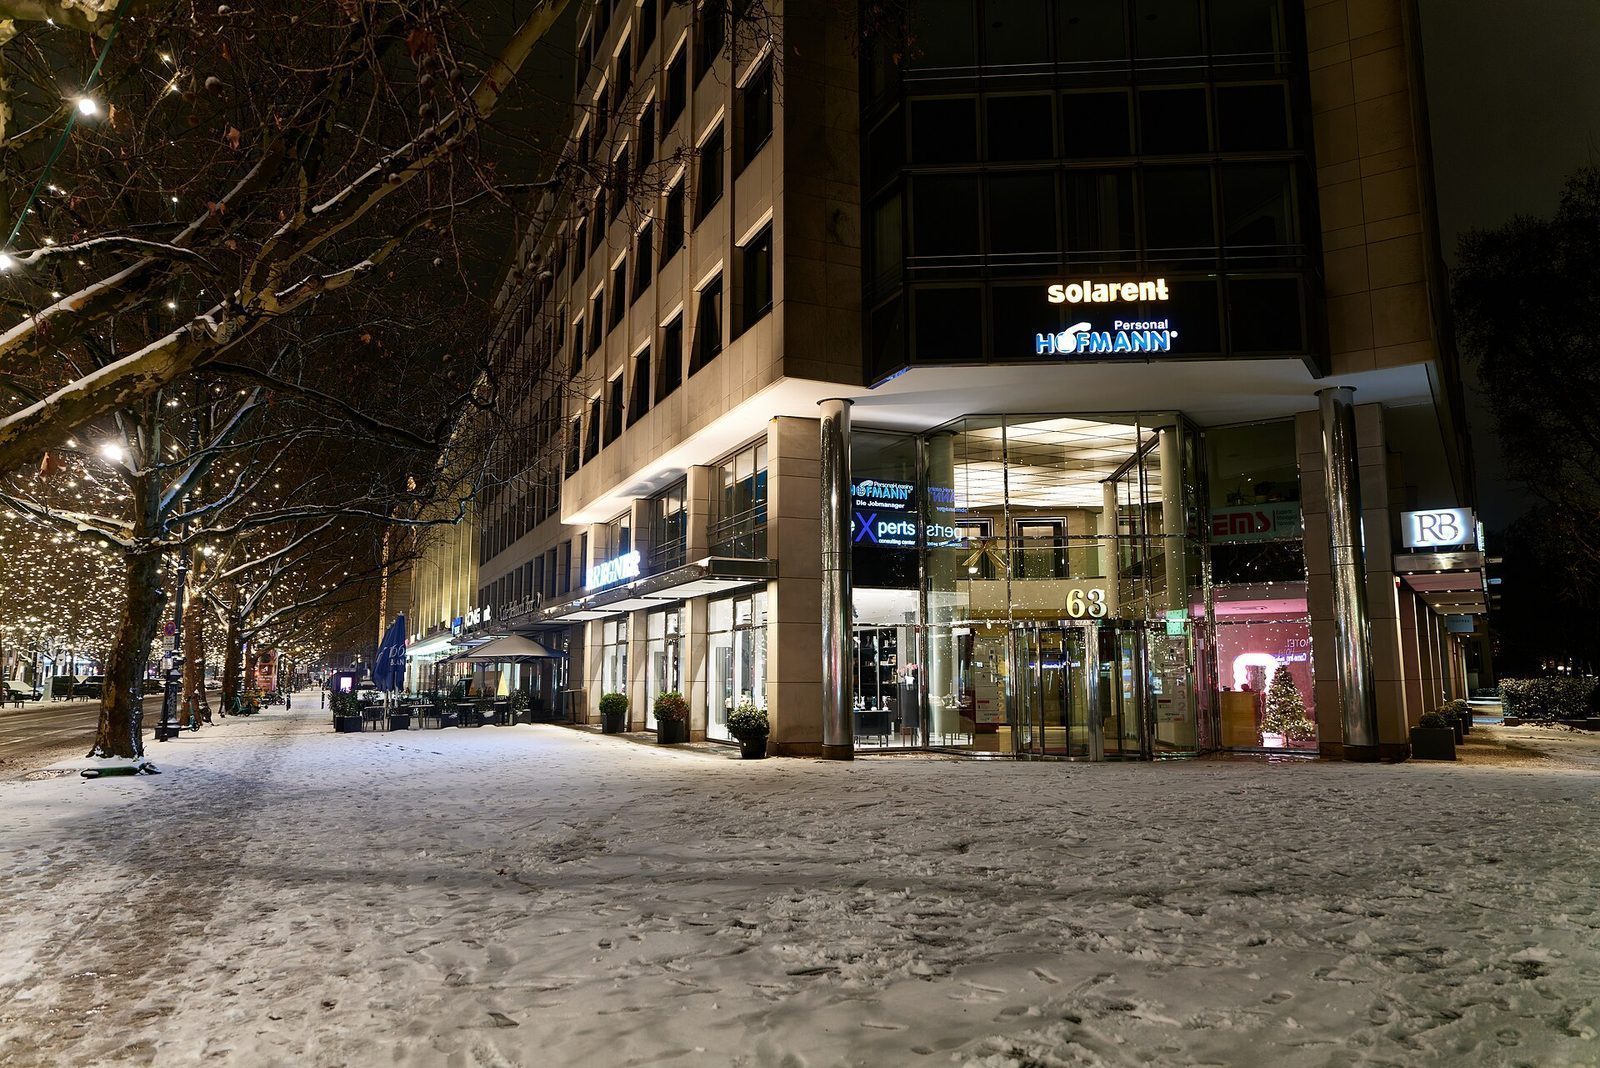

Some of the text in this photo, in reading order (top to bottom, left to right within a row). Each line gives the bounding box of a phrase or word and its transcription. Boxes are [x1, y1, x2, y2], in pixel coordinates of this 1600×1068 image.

[1047, 278, 1169, 303] solarent
[1114, 319, 1169, 330] Personal
[1035, 326, 1171, 354] HOFMANN
[867, 501, 905, 509] Jobmanager
[1414, 512, 1459, 543] RB
[1066, 588, 1107, 618] 63
